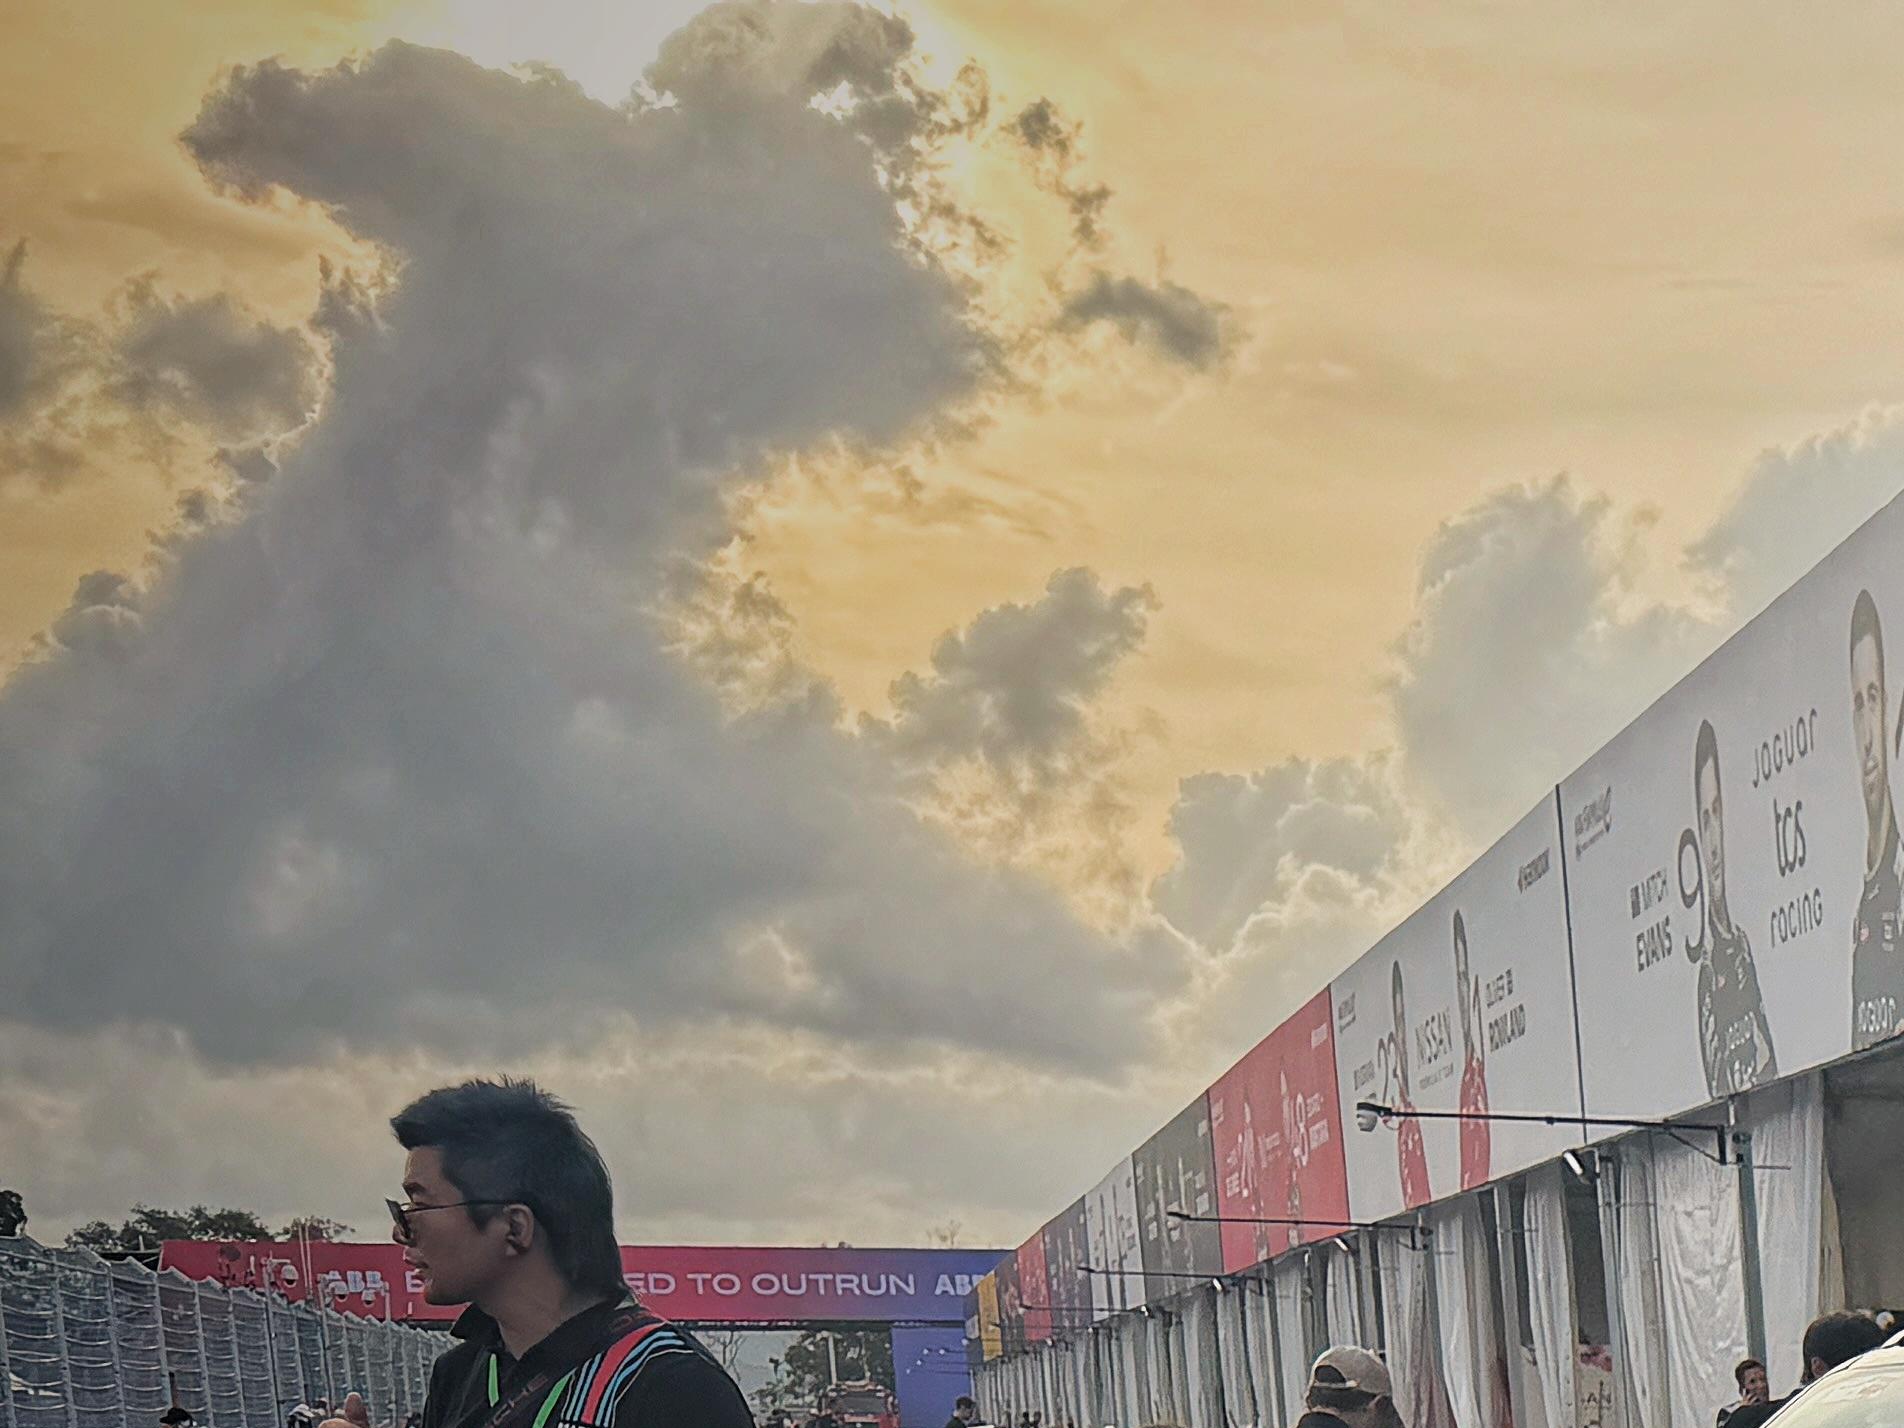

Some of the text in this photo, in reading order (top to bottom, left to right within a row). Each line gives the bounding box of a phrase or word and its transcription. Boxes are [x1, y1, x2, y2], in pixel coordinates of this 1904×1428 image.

[1773, 799, 1807, 877] tcs
[1677, 827, 1706, 964] 9
[1769, 887, 1824, 949] racing
[1636, 914, 1673, 974] EVANS
[1414, 1004, 1453, 1073] NISSAN
[687, 1272, 741, 1297] TO
[751, 1272, 916, 1298] OUTRUN
